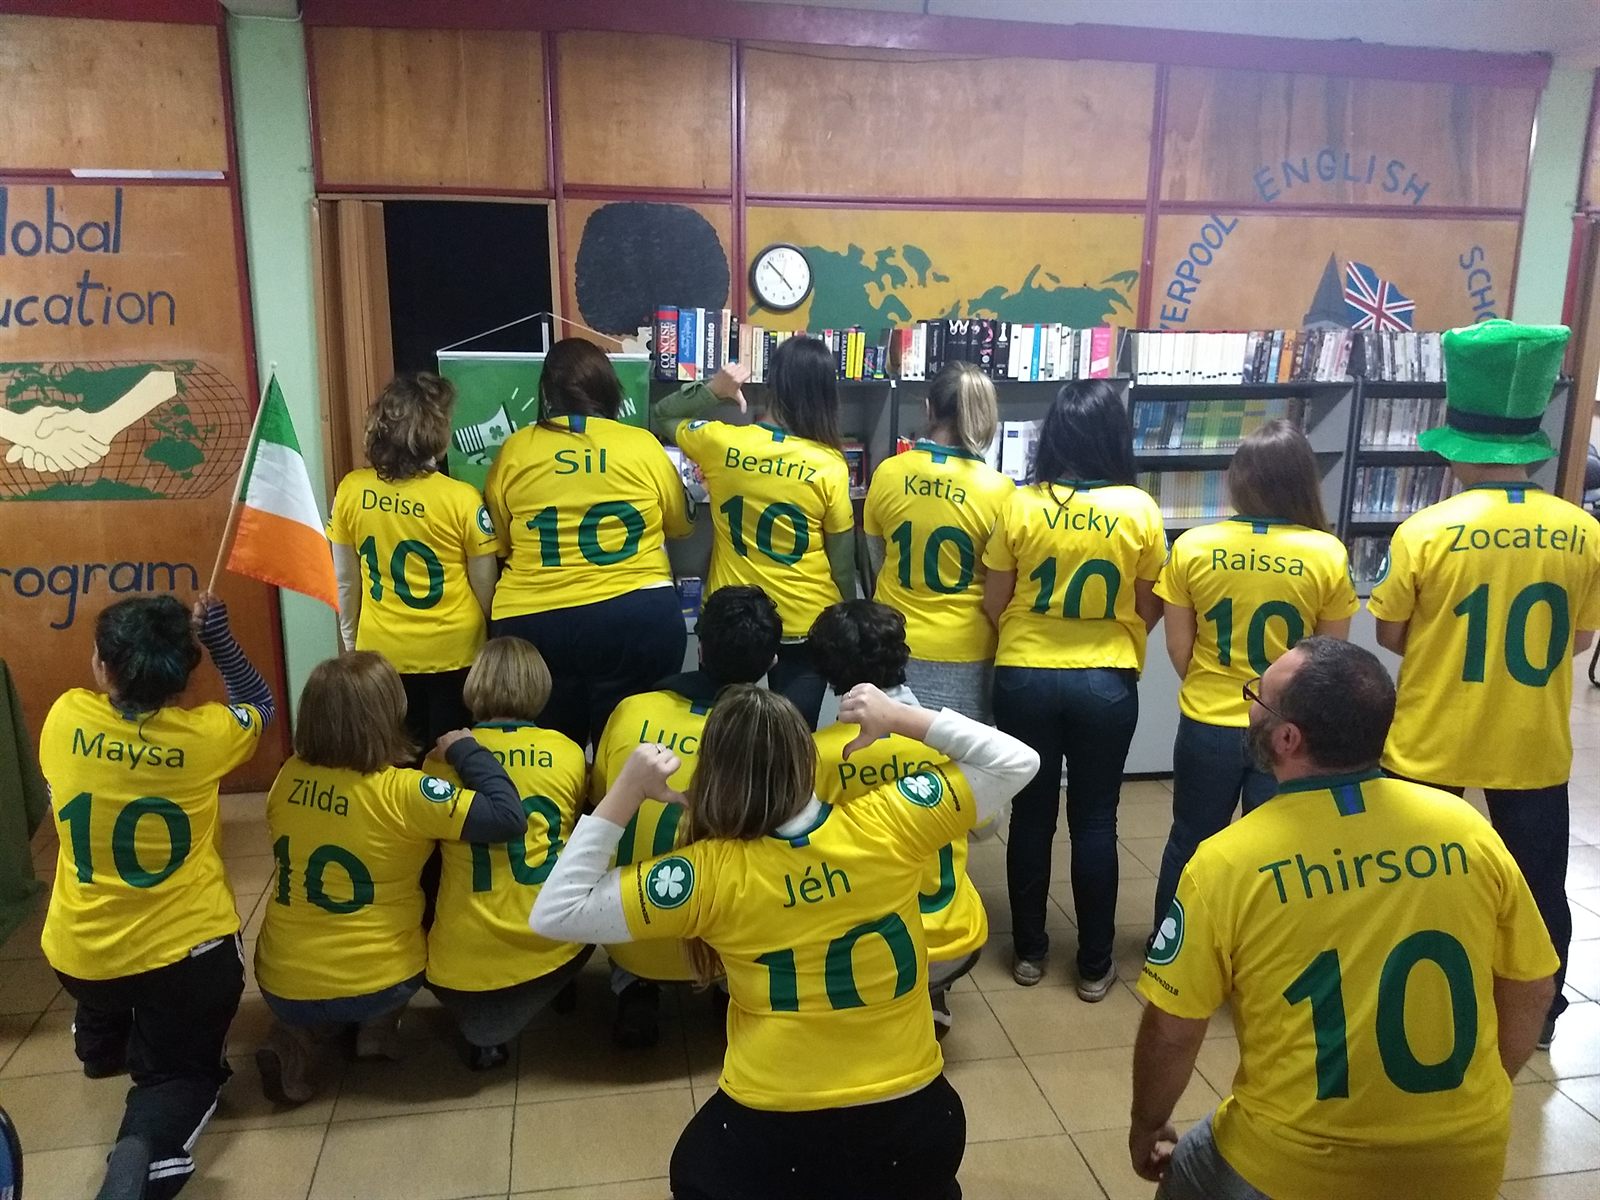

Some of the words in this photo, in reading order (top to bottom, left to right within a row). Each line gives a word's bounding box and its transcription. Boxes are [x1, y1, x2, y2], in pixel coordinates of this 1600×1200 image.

[1253, 150, 1430, 204] ENGLISH
[1160, 209, 1239, 329] ERPOOL
[660, 321, 669, 368] CONCISE
[707, 322, 715, 369] DICIONÁRIO
[554, 449, 607, 475] Sil
[724, 447, 817, 484] Beatriz
[362, 489, 425, 519] Deise
[904, 475, 966, 505] Katia
[526, 501, 647, 567] 10
[720, 495, 810, 566] 10
[1043, 507, 1119, 538] Vicky
[1446, 524, 1587, 555] Zocateli
[359, 535, 444, 610] 10
[891, 521, 975, 594] 10
[1212, 548, 1304, 576] Raissa
[1029, 556, 1121, 619] 10
[1204, 597, 1304, 675] 10
[1453, 581, 1570, 687] 10
[72, 727, 185, 771] Maysa
[492, 743, 553, 768] onia
[639, 719, 698, 755] Luc
[288, 778, 349, 817] Zilda
[58, 791, 192, 888] 10
[273, 834, 375, 914] 10
[783, 861, 852, 908] Jéh
[1258, 841, 1469, 904] Thirson
[753, 911, 918, 1012] 10
[1282, 929, 1478, 1100] 10
